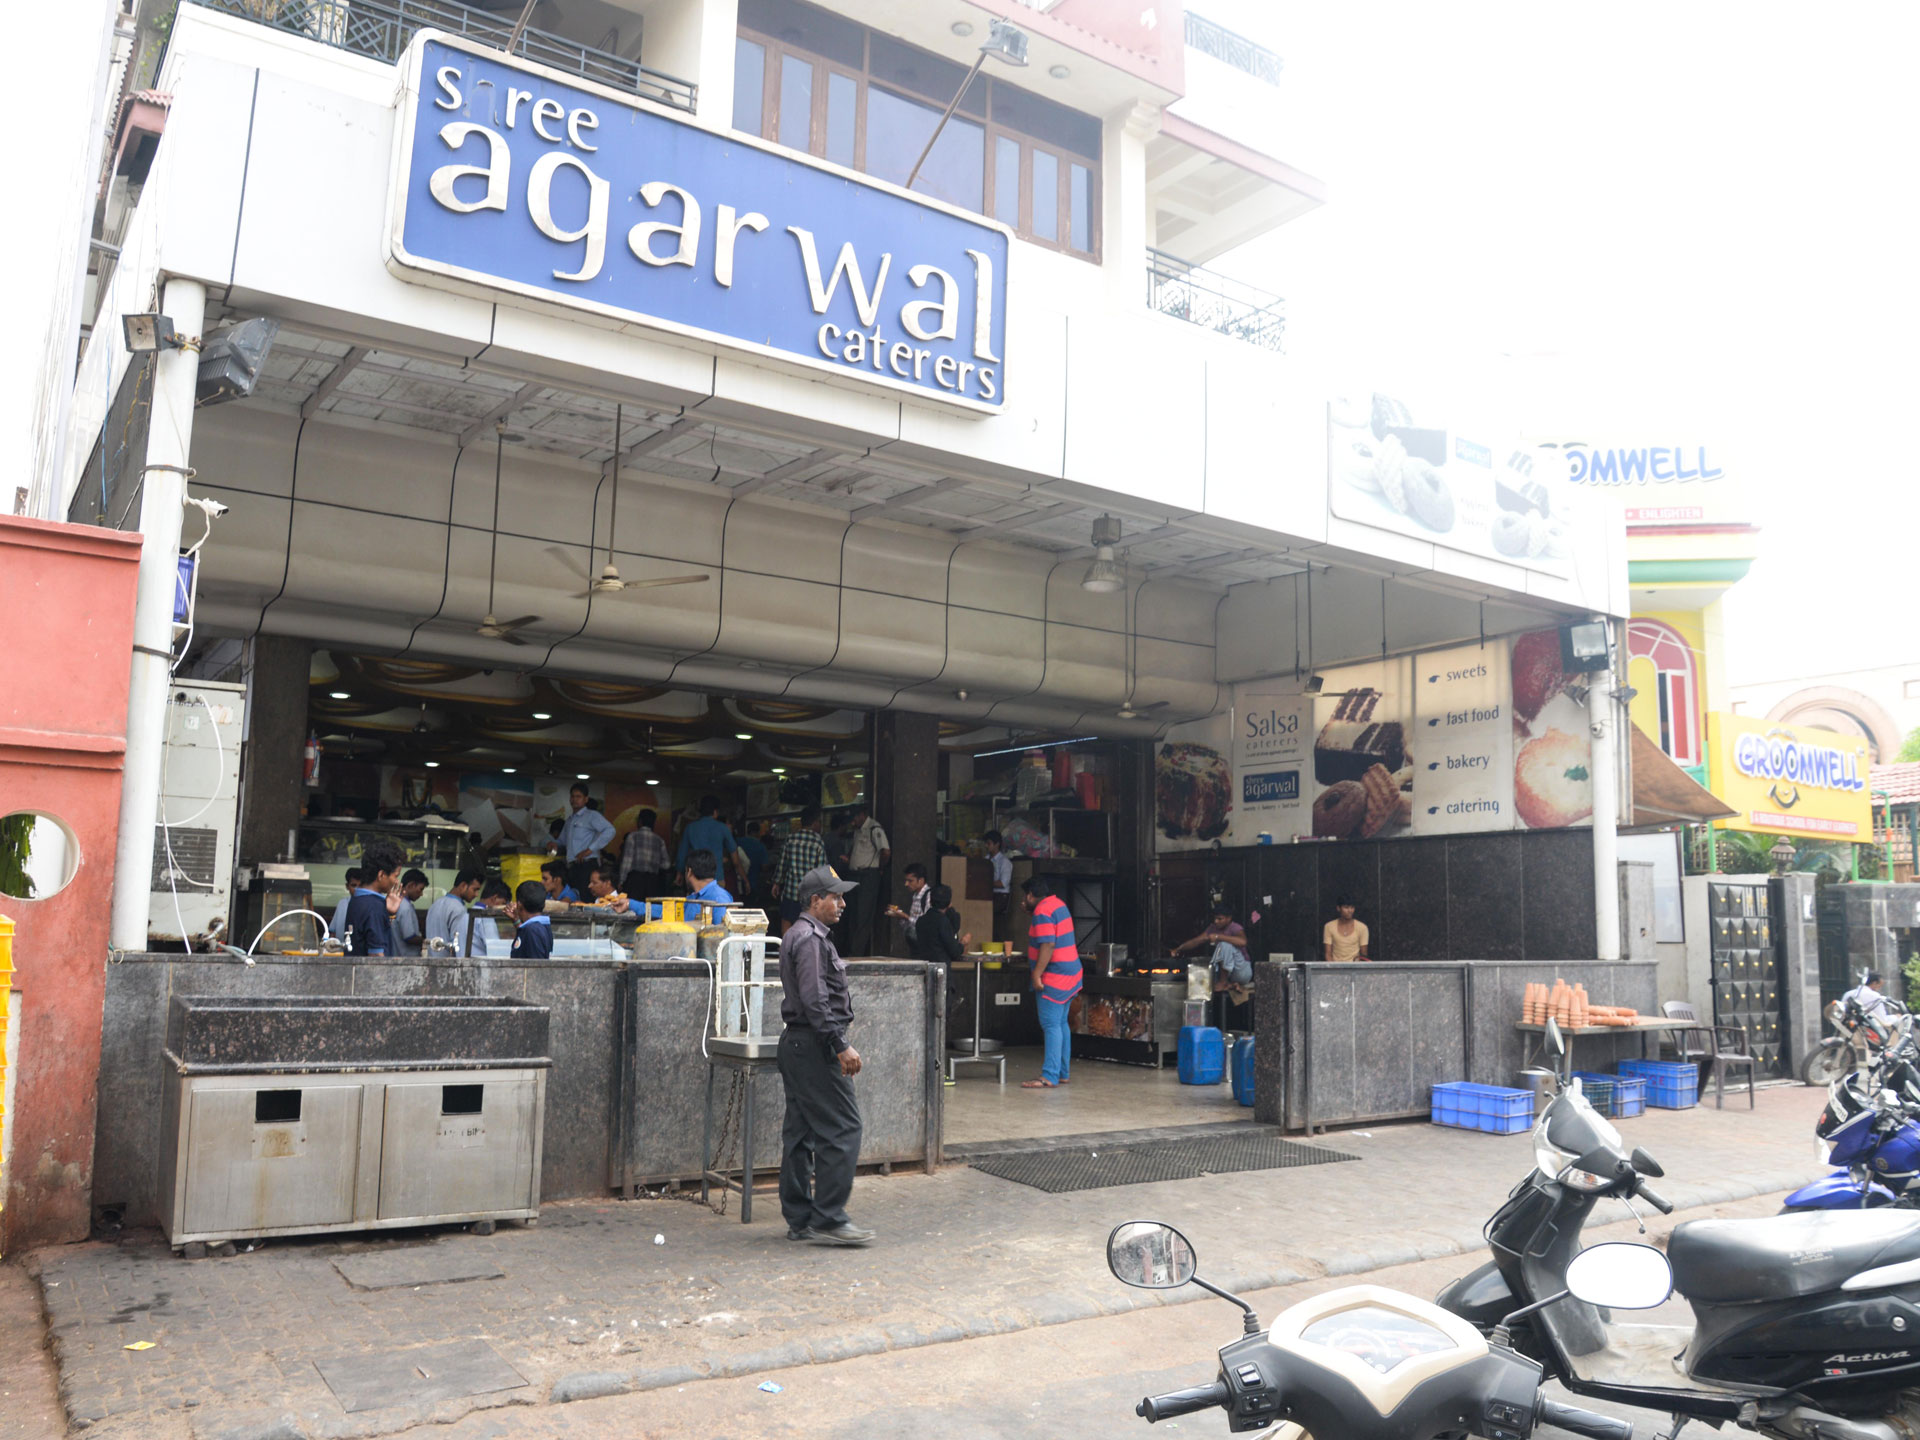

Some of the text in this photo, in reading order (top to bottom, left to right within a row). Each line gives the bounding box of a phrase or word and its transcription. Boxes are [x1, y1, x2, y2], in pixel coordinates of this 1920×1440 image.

[817, 321, 997, 400] caterers
[1446, 664, 1487, 681] sweets
[1246, 709, 1298, 738] Salsa
[1446, 705, 1499, 726] fast food
[1246, 738, 1298, 750] caterers
[1446, 754, 1490, 771] bakery
[1738, 735, 1864, 790] GROOMWELL
[1245, 776, 1296, 799] agarwal
[1446, 797, 1500, 816] catering
[1823, 1350, 1911, 1364] Activa
